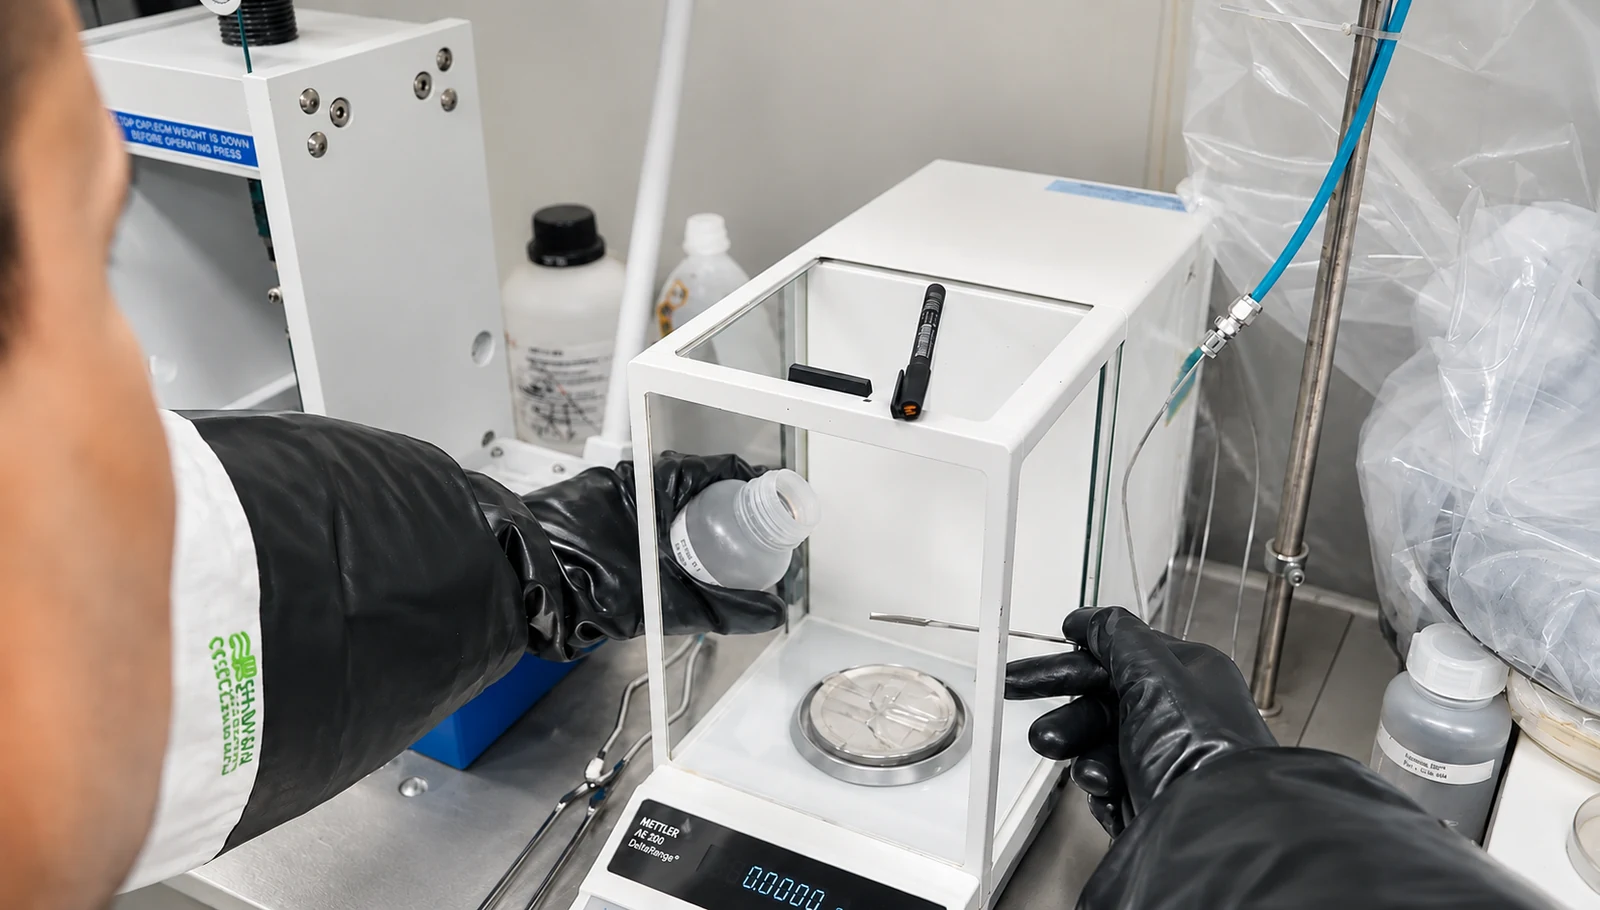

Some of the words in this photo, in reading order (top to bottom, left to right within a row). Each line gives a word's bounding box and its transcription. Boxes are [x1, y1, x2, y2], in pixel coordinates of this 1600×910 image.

[131, 130, 163, 145] BEFORE
[165, 137, 212, 154] OPERATING
[214, 146, 242, 160] PRESS
[173, 125, 206, 141] WEIGHT
[209, 133, 218, 143] IS
[221, 135, 250, 149] DOWN
[634, 828, 647, 840] AE
[647, 832, 665, 846] 200
[639, 816, 680, 839] METTLER
[742, 865, 826, 910] 0.0000
